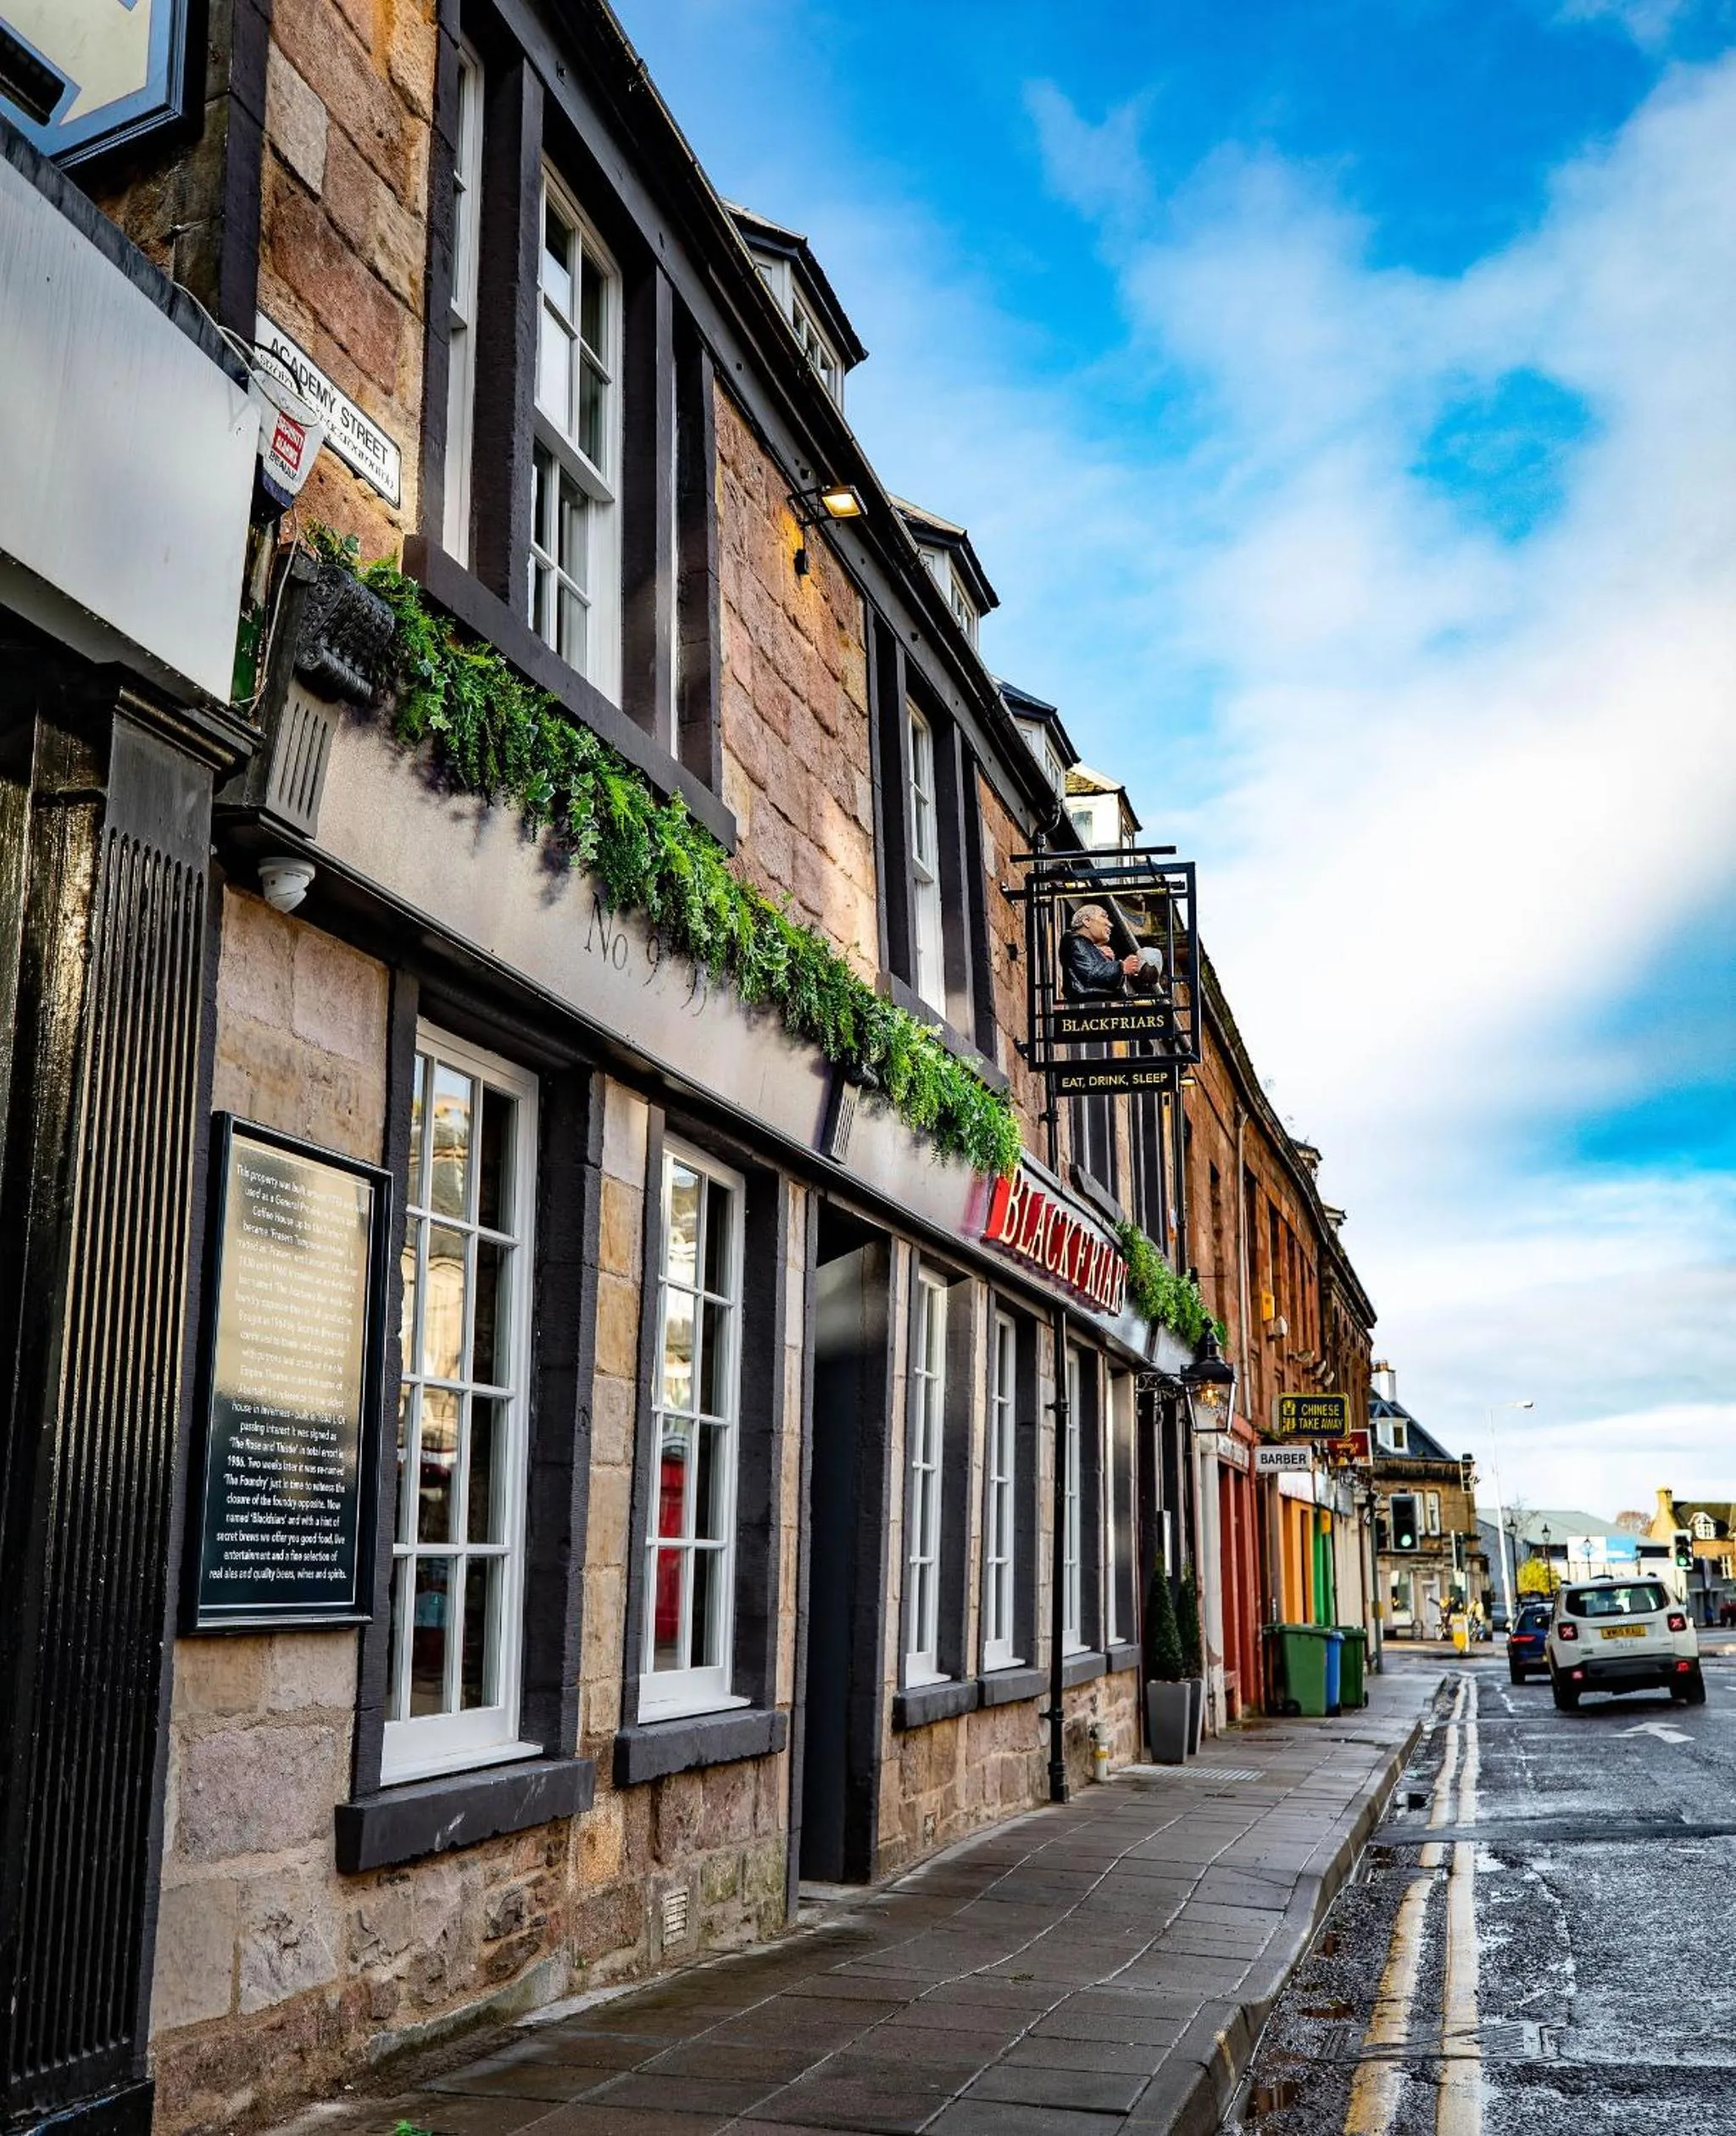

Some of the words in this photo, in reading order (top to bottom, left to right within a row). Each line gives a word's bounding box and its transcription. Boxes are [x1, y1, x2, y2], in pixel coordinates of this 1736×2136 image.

[271, 338, 337, 414] ACADEMY
[340, 407, 388, 465] STREET
[1062, 1015, 1165, 1032] BLACKFRIARS
[1062, 1077, 1085, 1088] EAT,
[1088, 1074, 1128, 1086] DRINK,
[1132, 1072, 1168, 1084] SLEEP
[231, 1399, 252, 1414] house
[1301, 1403, 1340, 1416] CHINESE
[240, 1421, 265, 1435] passing
[1299, 1417, 1320, 1430] TAKE
[1321, 1418, 1344, 1430] AWAY
[263, 1440, 275, 1451] and
[248, 1456, 261, 1469] Two
[1260, 1453, 1307, 1465] BARBER
[269, 1477, 282, 1491] just
[290, 1478, 303, 1490] time
[313, 1481, 335, 1492] witness
[336, 1482, 346, 1494] the
[225, 1492, 251, 1505] closure
[252, 1494, 260, 1505] of
[260, 1494, 272, 1506] the
[272, 1494, 297, 1510] foundry
[225, 1511, 250, 1523] named
[287, 1514, 300, 1525] and
[301, 1515, 314, 1526] with
[320, 1516, 332, 1527] hint
[332, 1516, 340, 1527] of
[216, 1532, 238, 1542] secret
[239, 1529, 259, 1543] brews
[260, 1532, 270, 1543] we
[270, 1530, 287, 1543] offer
[287, 1533, 299, 1546] you
[299, 1532, 317, 1546] good
[334, 1532, 346, 1544] live
[223, 1548, 271, 1560] entertainment
[271, 1548, 284, 1560] and
[290, 1549, 303, 1561] fine
[303, 1549, 330, 1561] selection
[330, 1549, 339, 1561] of
[209, 1566, 223, 1579] real
[224, 1566, 238, 1579] ales
[238, 1566, 253, 1579] and
[253, 1567, 275, 1582] quality
[297, 1567, 314, 1579] wines
[314, 1567, 327, 1579] and
